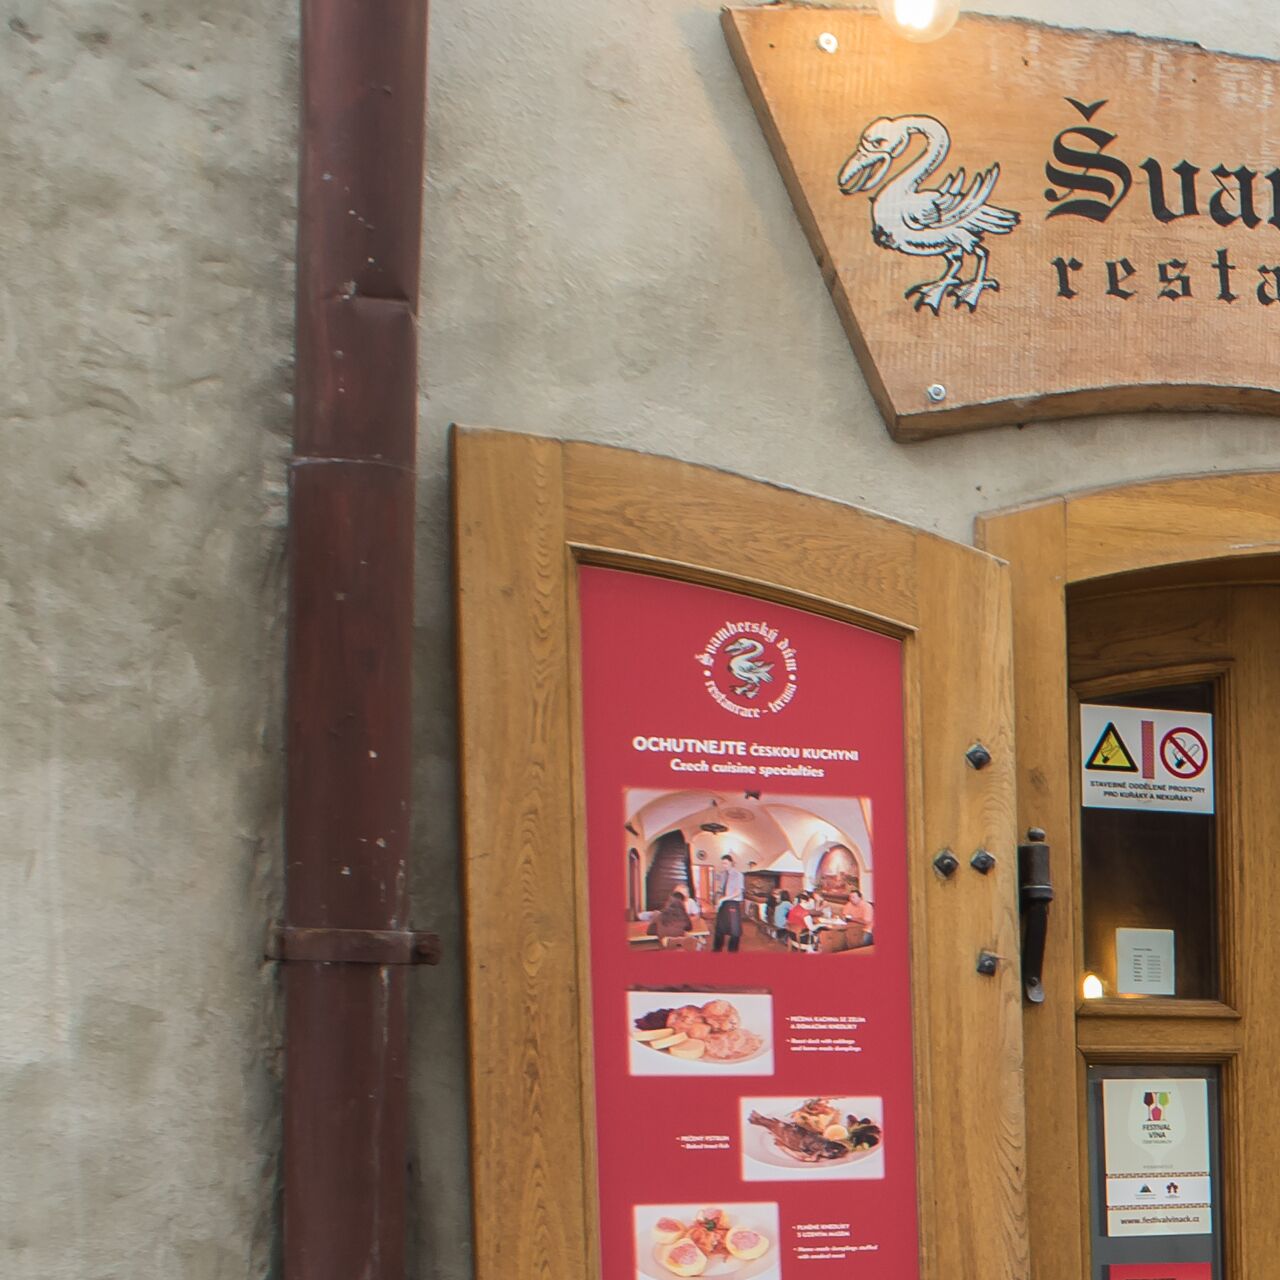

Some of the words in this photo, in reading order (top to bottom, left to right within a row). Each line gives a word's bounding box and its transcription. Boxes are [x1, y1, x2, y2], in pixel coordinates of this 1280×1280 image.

[632, 735, 747, 756] OCHUTNEJTE
[750, 742, 800, 758] ČESKOU
[670, 758, 709, 772] Czech
[711, 762, 756, 775] cuisine
